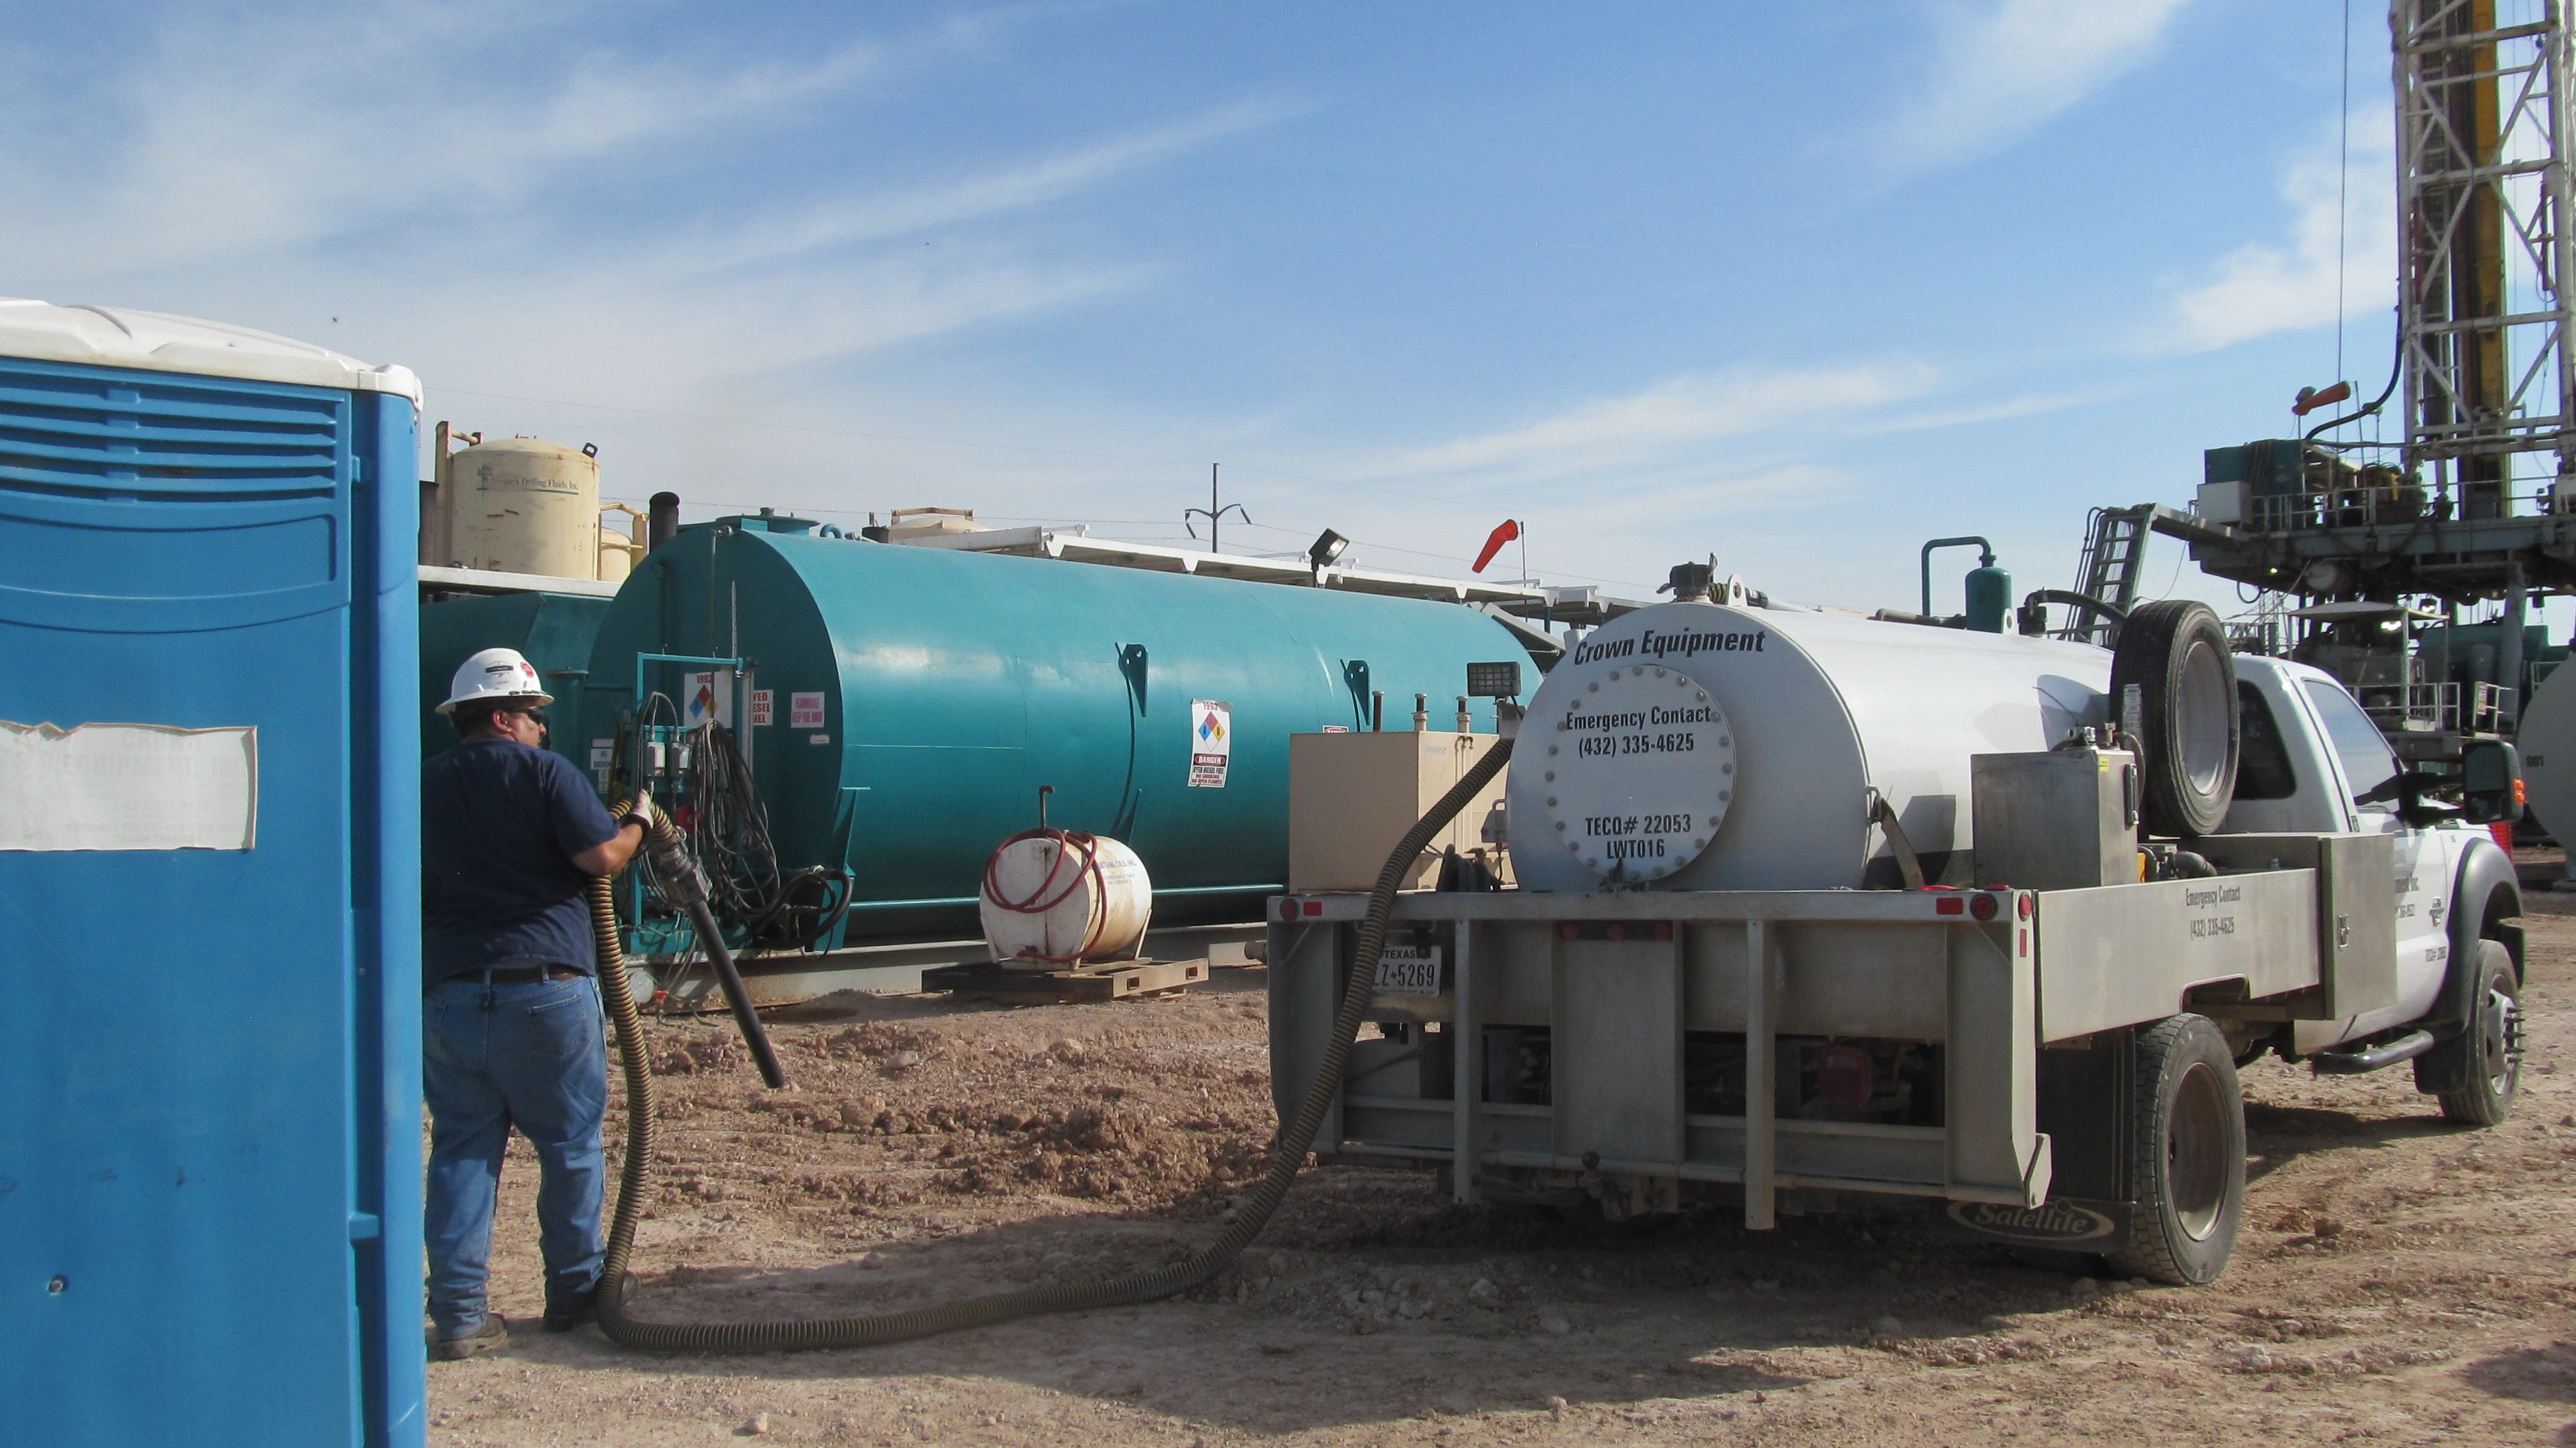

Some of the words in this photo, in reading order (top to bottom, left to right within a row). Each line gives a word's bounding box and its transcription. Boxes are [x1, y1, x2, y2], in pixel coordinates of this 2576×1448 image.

[1574, 641, 1635, 665] Crown
[1640, 627, 1766, 659] Equipment
[753, 703, 771, 712] ESEL
[1203, 702, 1219, 711] 1993
[1566, 712, 1646, 732] Emergency
[1651, 705, 1711, 725] Contact
[1578, 736, 1616, 758] (432)
[1622, 733, 1694, 754] 335-4625
[1199, 756, 1221, 764] DANGER
[1644, 813, 1691, 833] 22053
[1607, 838, 1665, 859] LWT016
[2186, 888, 2218, 909] Emergency
[2218, 884, 2241, 902] Contact
[2190, 919, 2206, 940] (432)
[1384, 950, 1417, 959] TEXAS
[1973, 1202, 2088, 1233] Satellite
